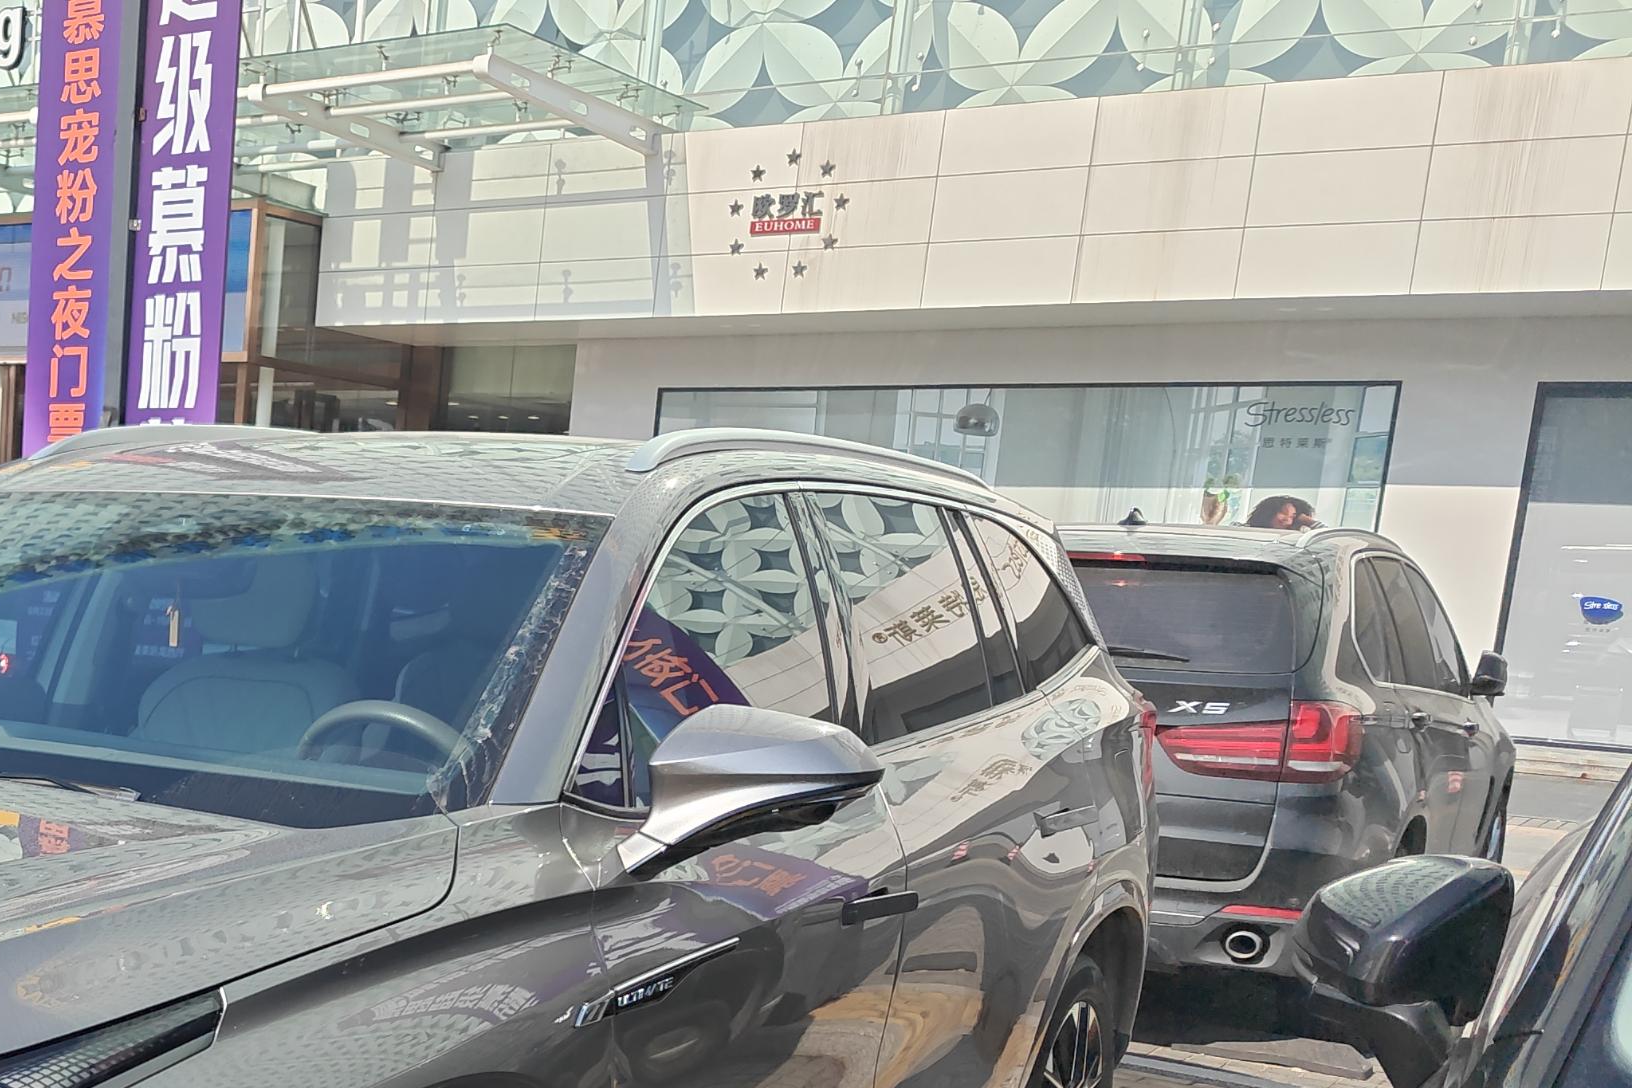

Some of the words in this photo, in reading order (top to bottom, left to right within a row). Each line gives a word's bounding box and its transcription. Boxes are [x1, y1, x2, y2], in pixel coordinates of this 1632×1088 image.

[137, 0, 218, 426] 级慕粉
[751, 190, 824, 219] 欧罗汇
[755, 220, 815, 232] EUHOME
[1244, 401, 1356, 427] Stressless
[1583, 601, 1620, 611] Stresless
[1166, 700, 1231, 714] X5
